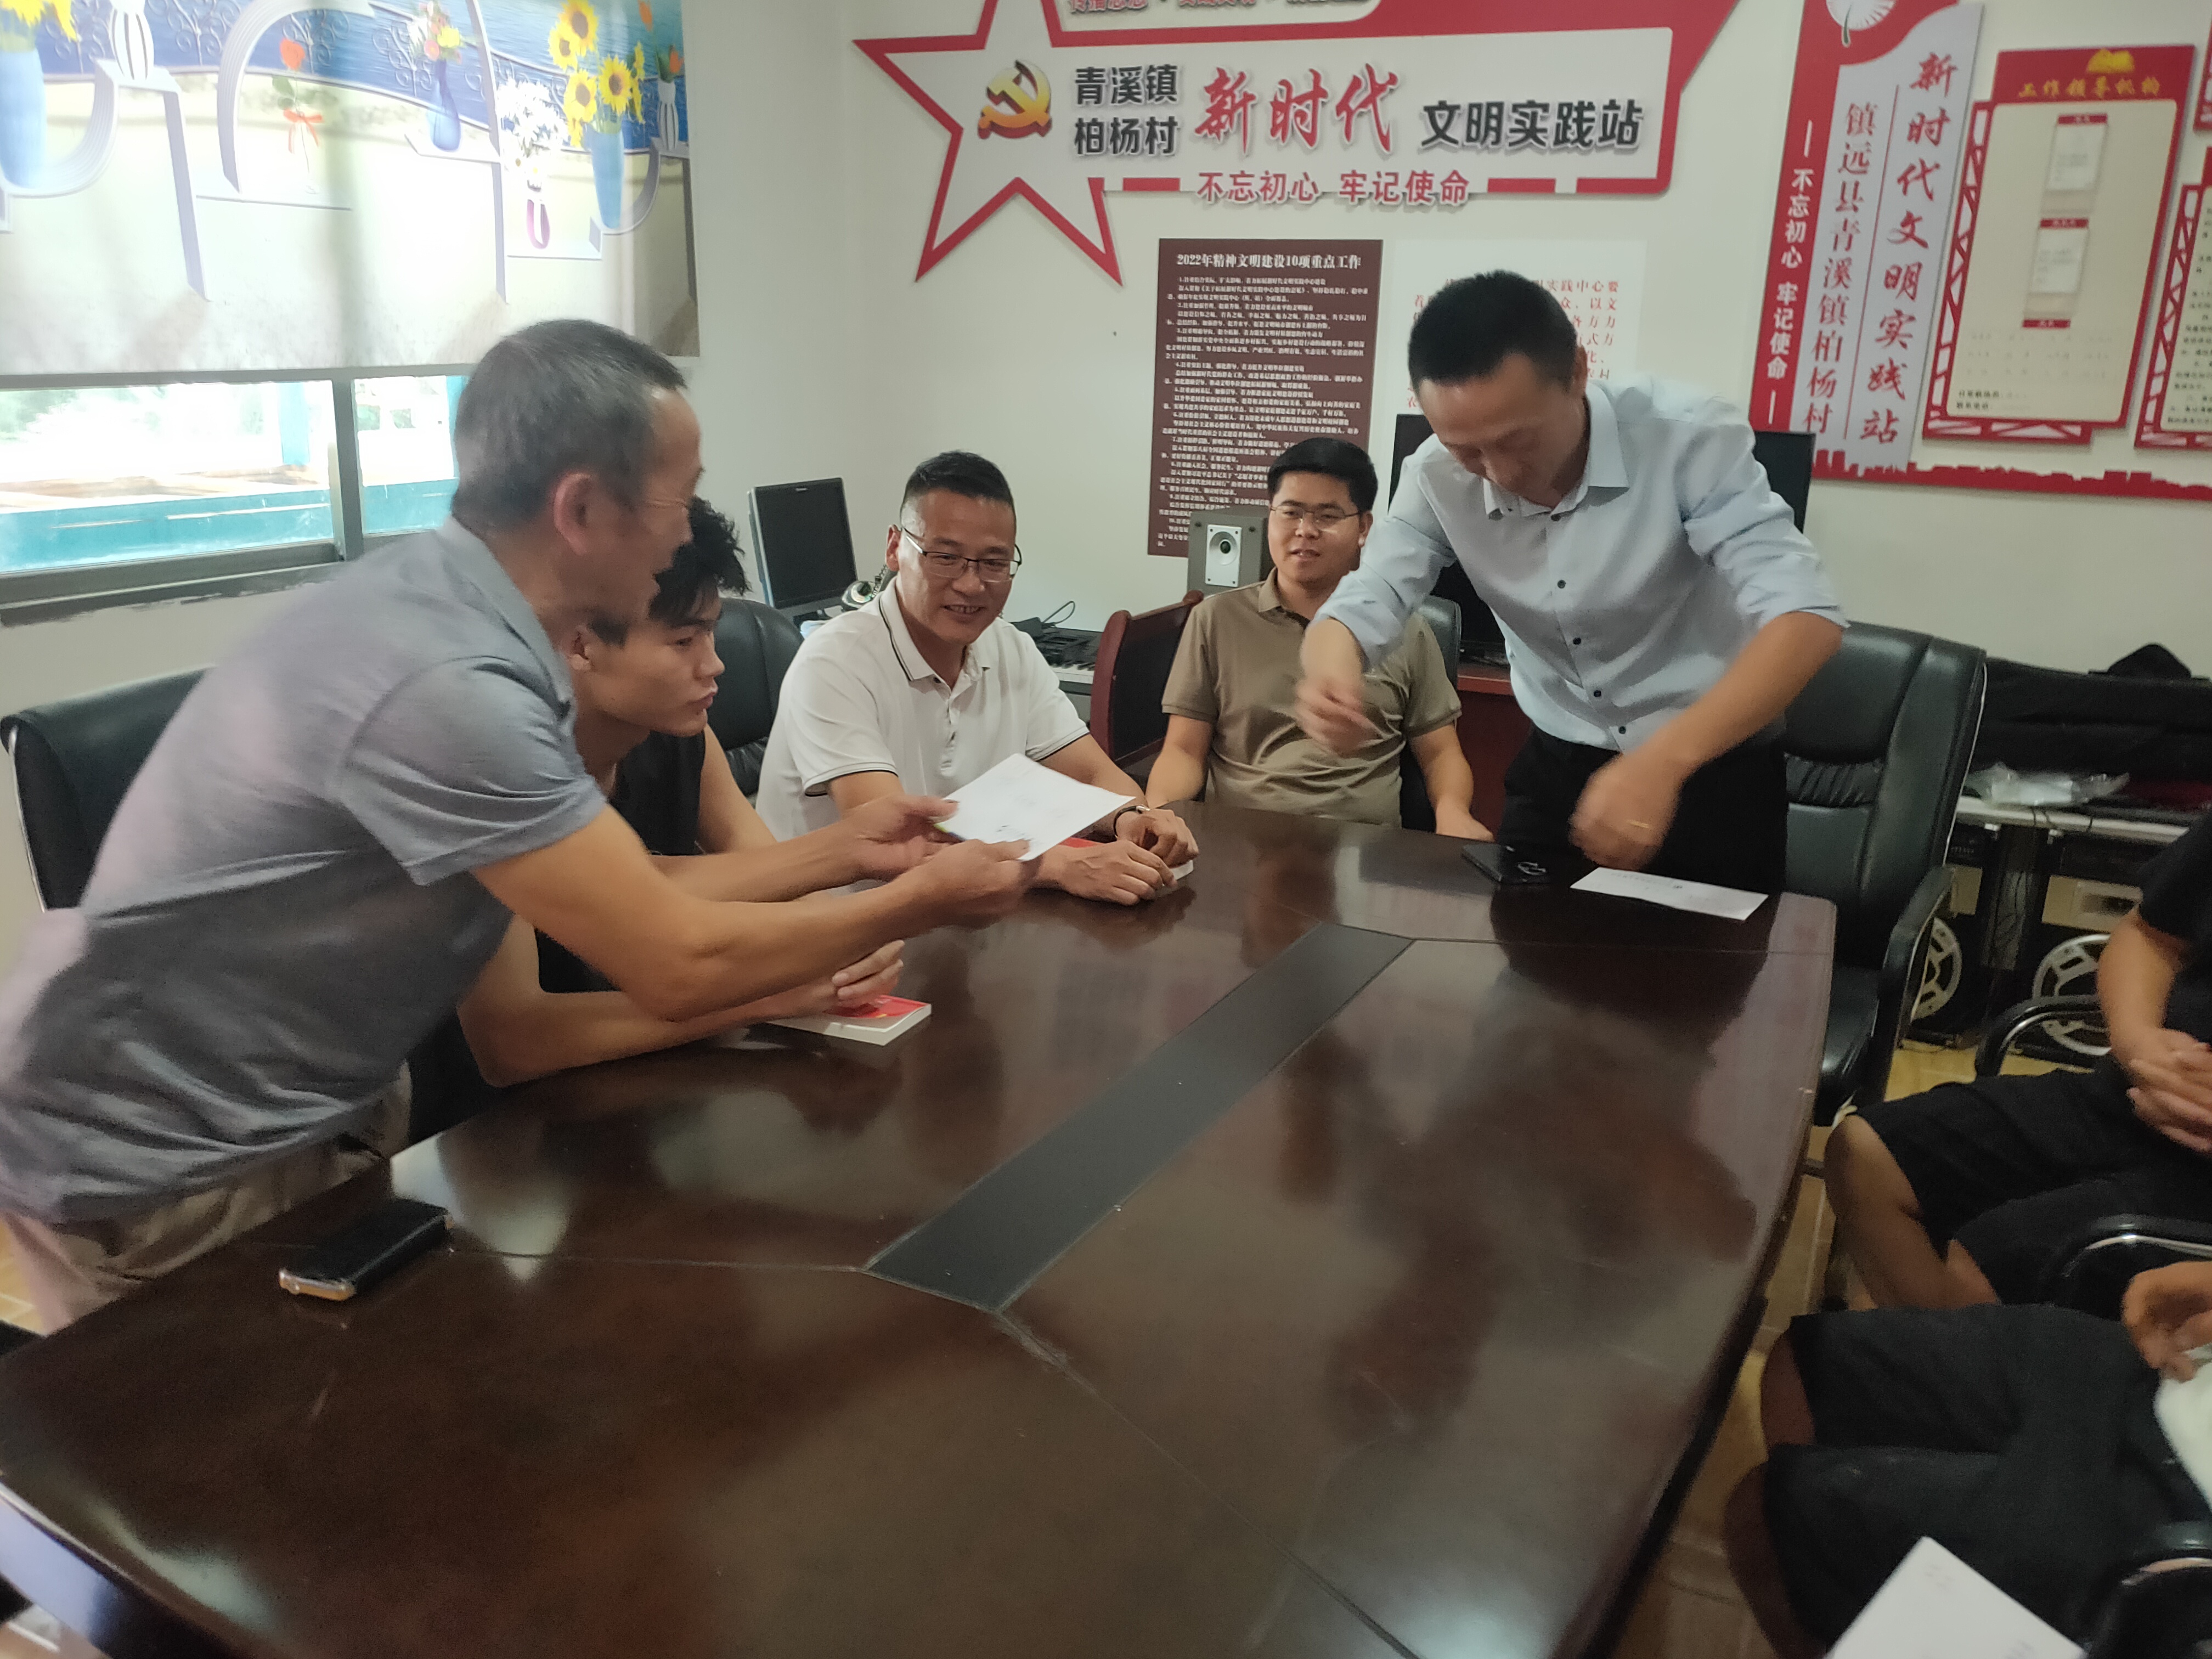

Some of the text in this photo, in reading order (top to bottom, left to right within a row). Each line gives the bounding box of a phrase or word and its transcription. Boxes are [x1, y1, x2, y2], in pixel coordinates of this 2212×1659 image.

[1075, 64, 1178, 104] 青溪镇
[1194, 63, 1643, 155] 新时代 文明实践站
[1074, 116, 1178, 155] 柏杨村
[1197, 170, 1470, 204] 不忘初心 牢记使命
[1177, 253, 1362, 269] 2022年精神文明建设10项重点工作
[1767, 168, 1814, 380] 不忘初心 牢记使命
[1803, 102, 1878, 433] 镇远县青溪镇柏杨村
[1860, 52, 1959, 444] 新时代文明实践站
